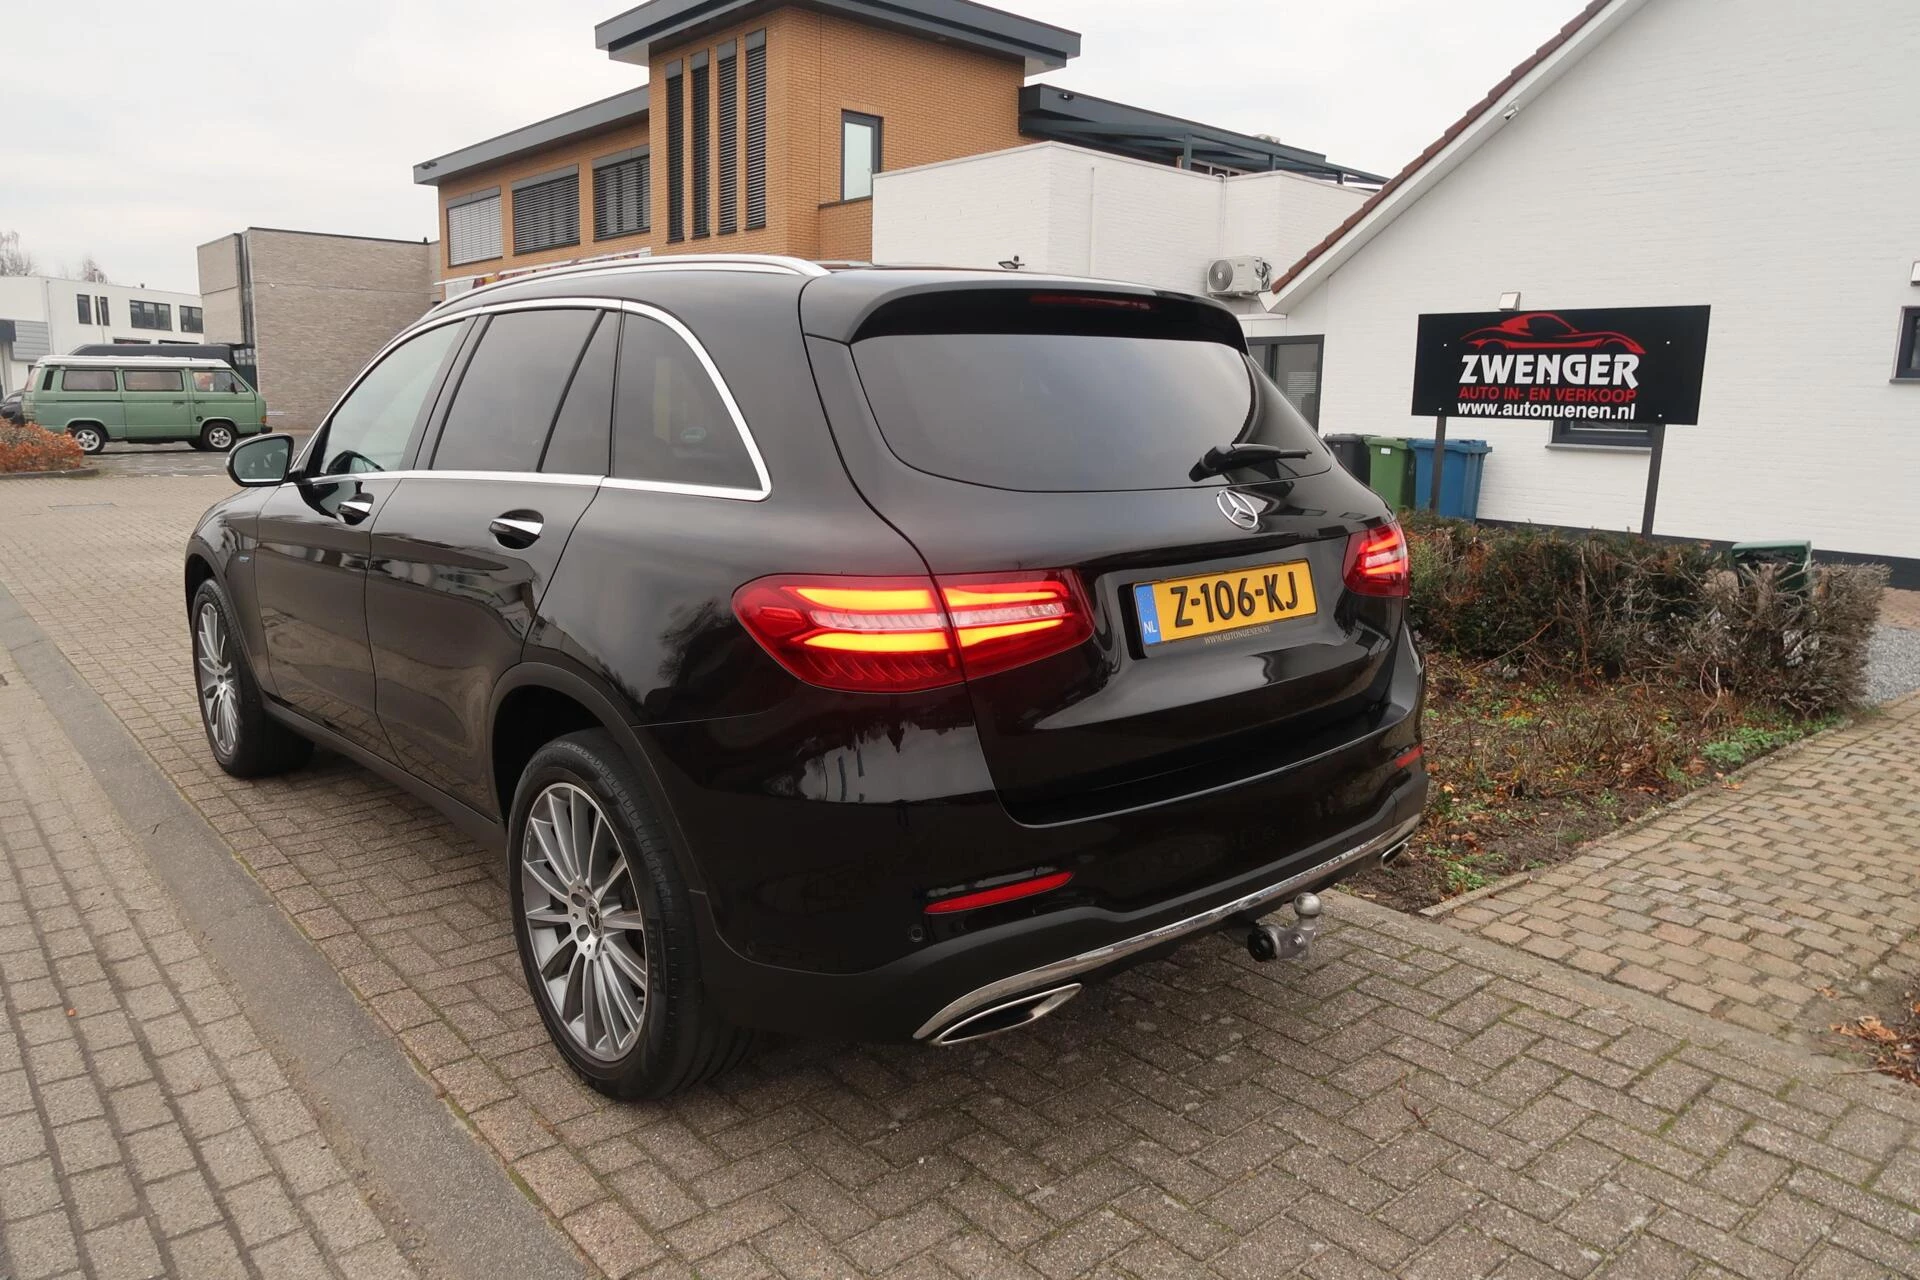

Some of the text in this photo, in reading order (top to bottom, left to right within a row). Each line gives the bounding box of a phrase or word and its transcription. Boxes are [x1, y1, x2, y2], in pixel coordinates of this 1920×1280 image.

[1459, 354, 1639, 389] ZWENGER
[1459, 387, 1637, 402] AUTO IN- EN VERKOOP
[1457, 402, 1636, 420] www.autonuenen.nl
[1170, 572, 1298, 628] Z-106-KJ
[1143, 620, 1157, 633] NL
